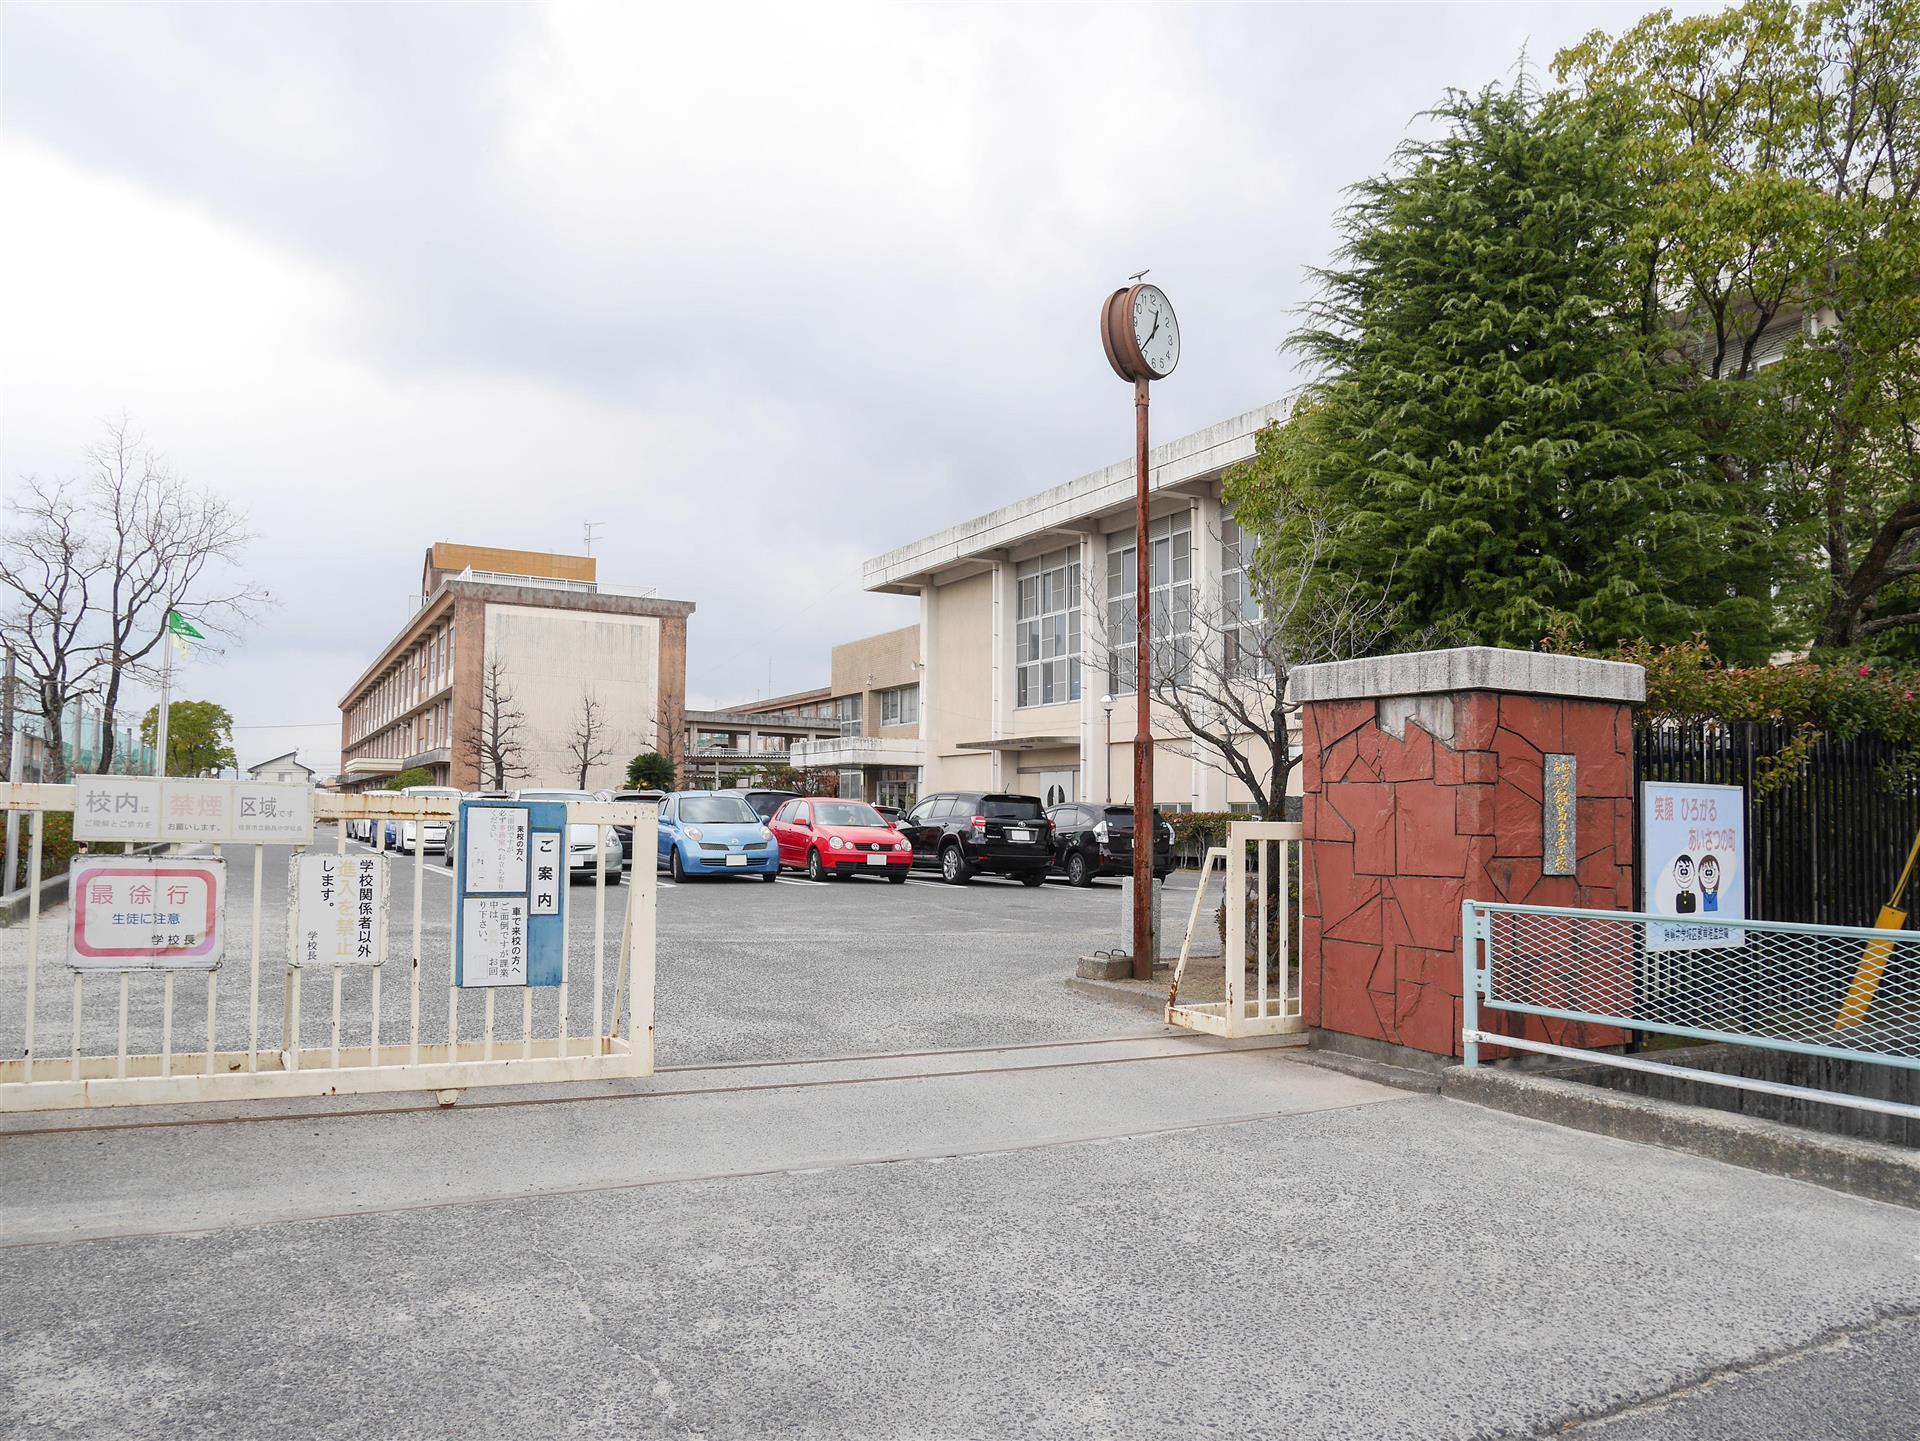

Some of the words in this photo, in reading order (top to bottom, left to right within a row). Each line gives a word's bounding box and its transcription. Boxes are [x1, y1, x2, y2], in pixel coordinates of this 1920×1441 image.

[1135, 303, 1142, 314] 10
[1140, 294, 1146, 305] 11
[1149, 294, 1156, 305] 12
[1165, 317, 1170, 327] 2
[1168, 335, 1173, 345] 3
[1151, 359, 1156, 368] 6
[1160, 359, 1164, 368] 5
[85, 789, 150, 814] 校内は
[170, 792, 223, 817] 禁煙
[239, 795, 295, 818] 区域です
[1654, 797, 1674, 822] 笑顔
[1680, 798, 1718, 822] ひろがる
[167, 822, 221, 833] お願いします。
[516, 825, 525, 862] 来校の方へ
[1688, 828, 1736, 852] あいさつの町
[320, 860, 335, 908] します。
[537, 838, 553, 909] ご案内
[90, 884, 190, 906] 最徐行
[111, 912, 182, 926] 生徒に注意
[335, 859, 356, 957] 進入を禁止
[357, 859, 374, 958] 学校関係者以外
[478, 900, 488, 942] り下さい。
[150, 933, 196, 946] 学校長
[307, 930, 318, 961] 学校長
[511, 906, 522, 974] 車で来校の方へ
